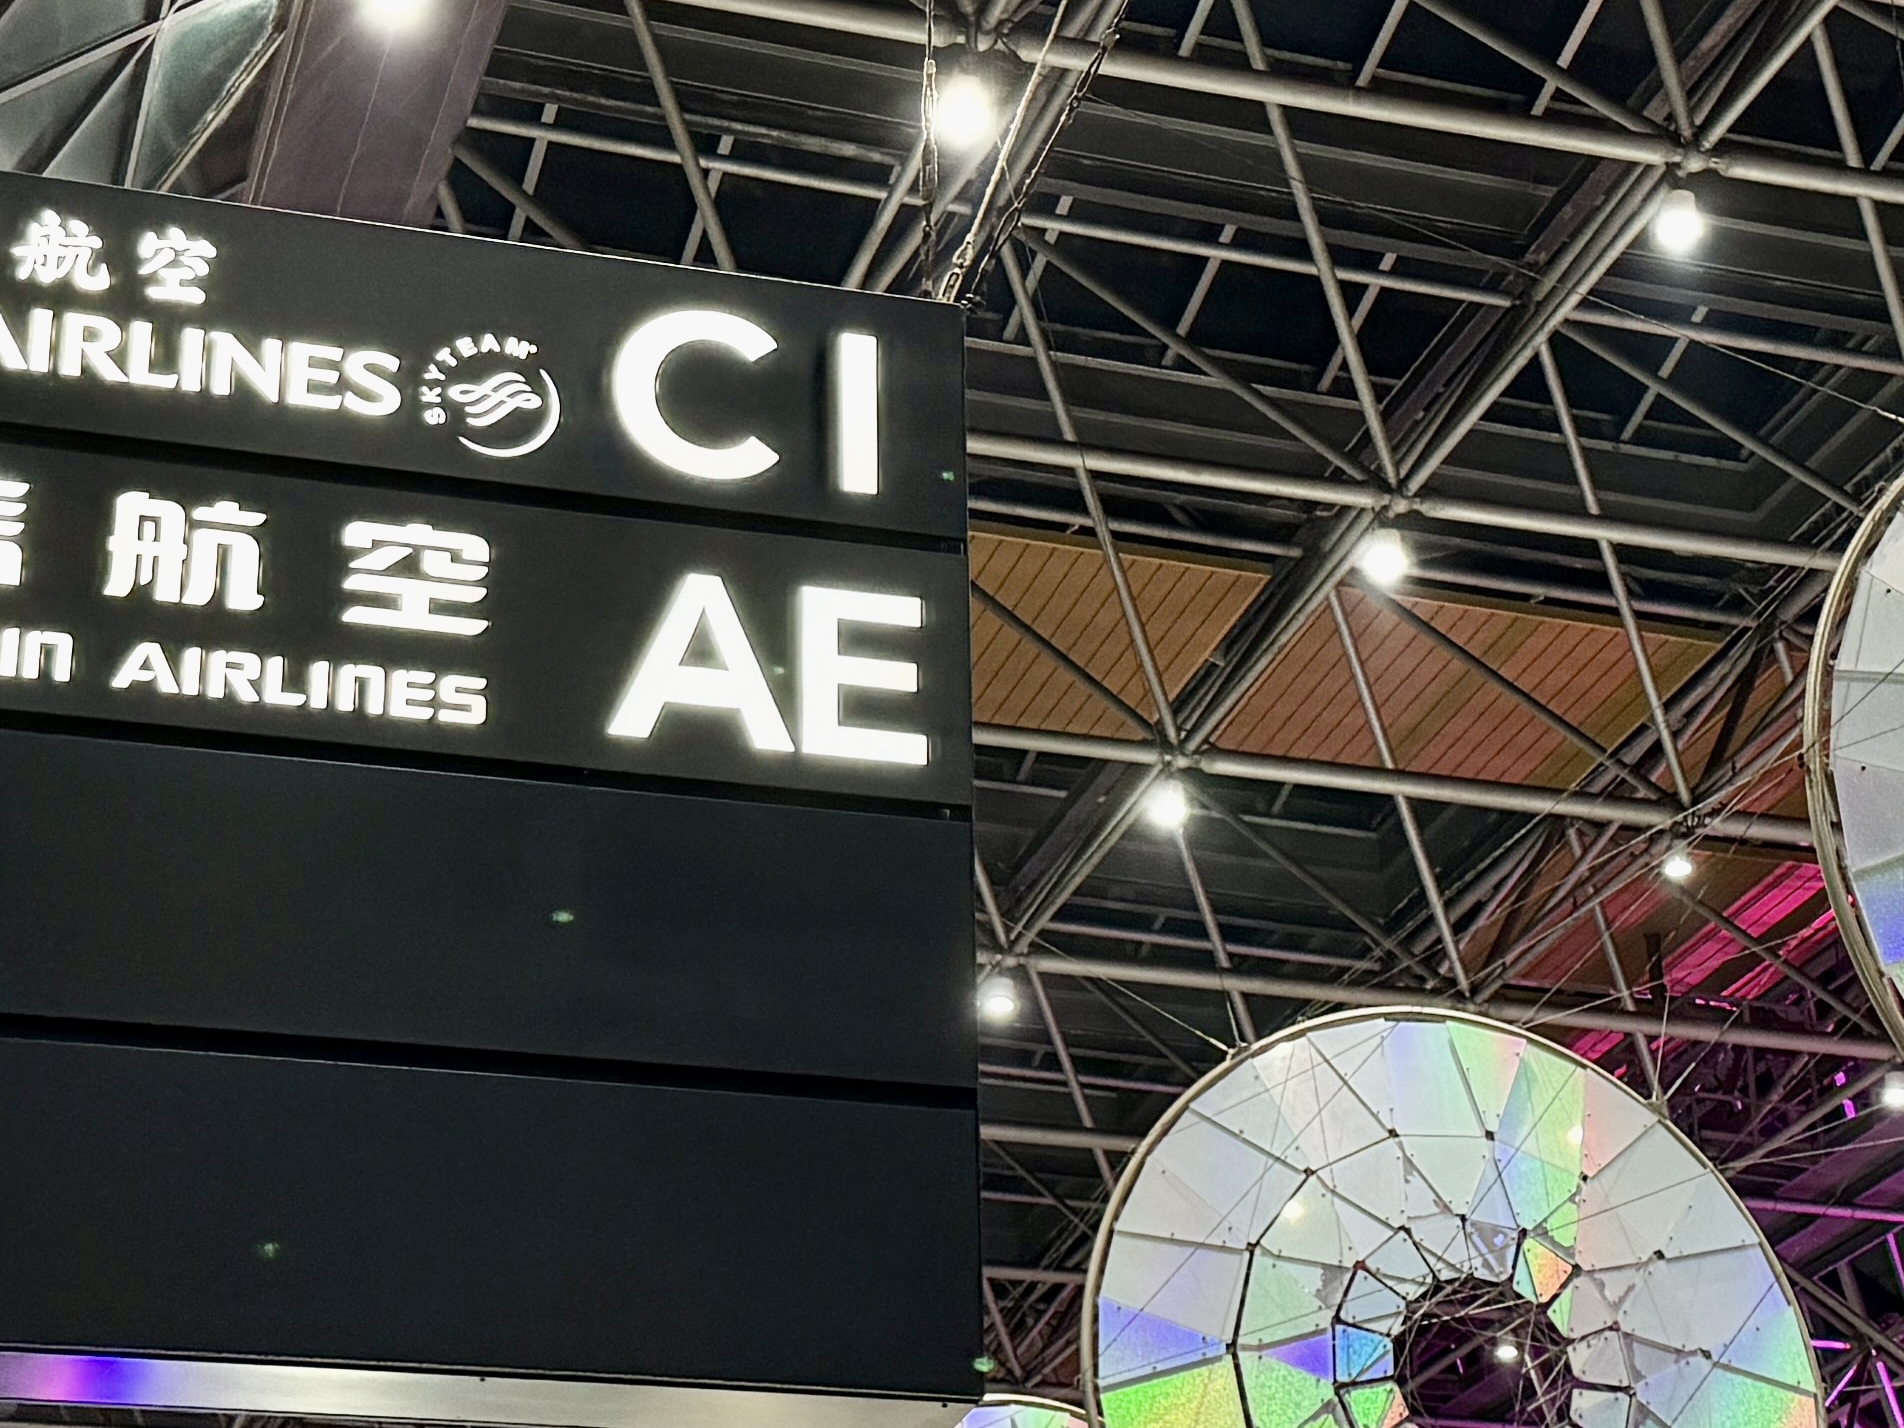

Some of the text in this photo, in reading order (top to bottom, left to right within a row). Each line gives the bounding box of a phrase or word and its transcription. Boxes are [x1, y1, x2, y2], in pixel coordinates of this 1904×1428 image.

[421, 333, 531, 425] SKYTEAM
[611, 308, 879, 496] CI
[110, 641, 488, 726] AIRLINES
[606, 572, 929, 766] AE
